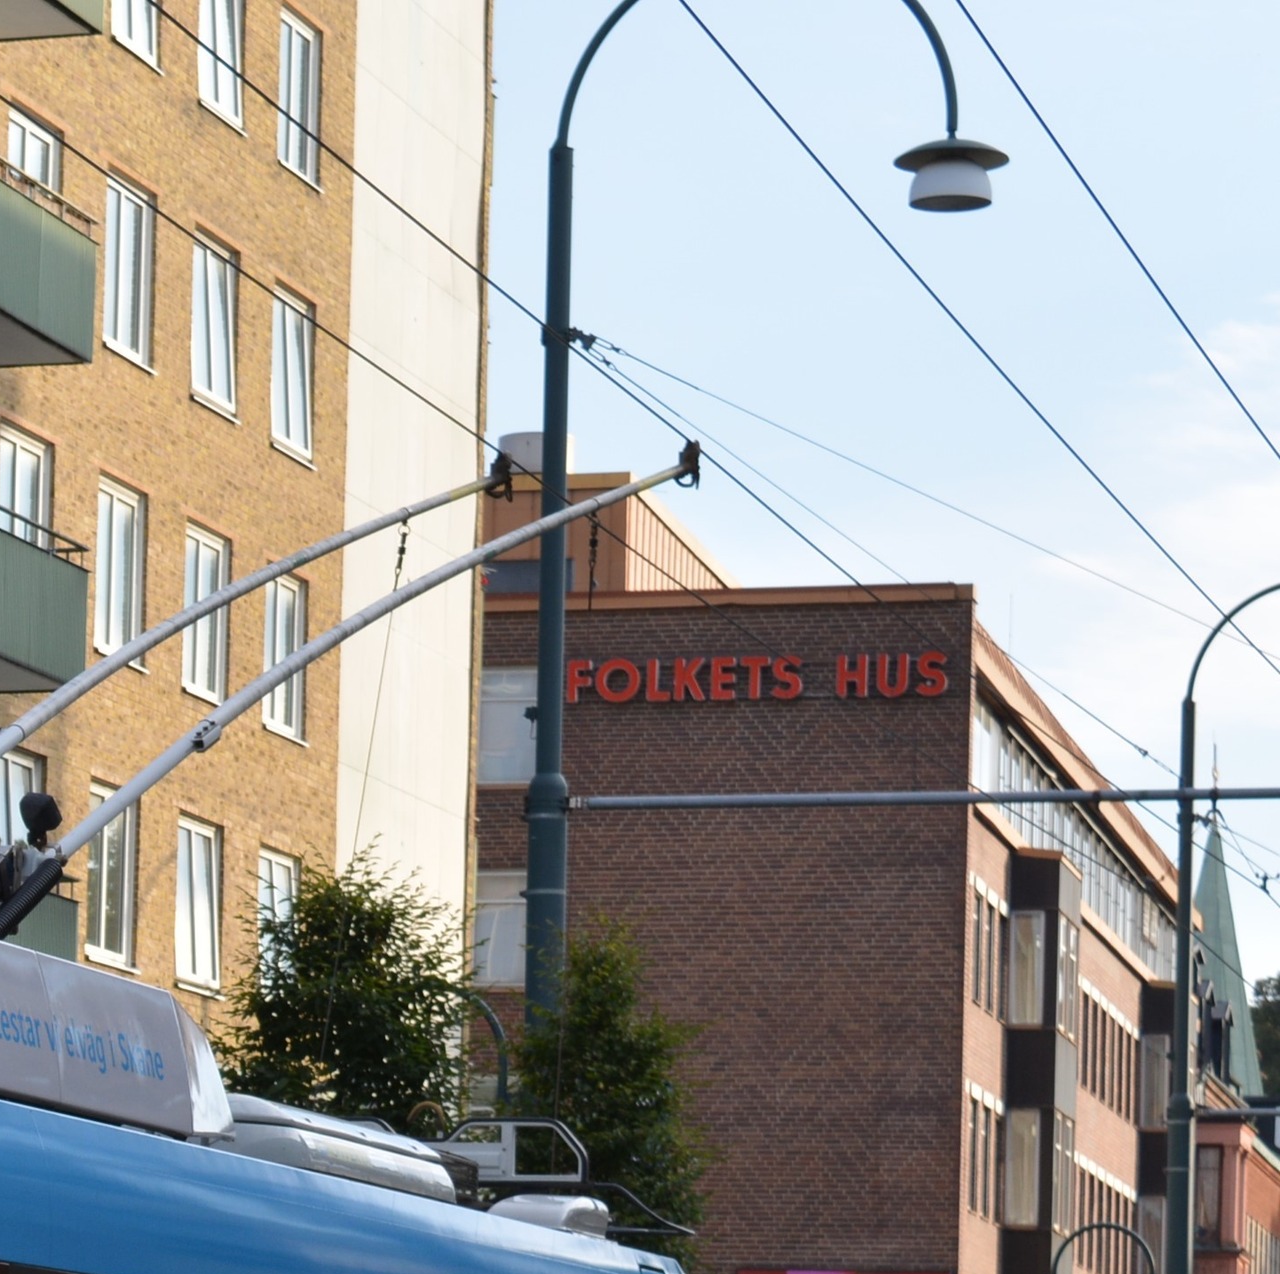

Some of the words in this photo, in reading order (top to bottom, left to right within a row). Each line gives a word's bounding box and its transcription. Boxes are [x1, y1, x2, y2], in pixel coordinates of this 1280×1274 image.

[566, 655, 803, 704] FOLKETS
[836, 651, 949, 698] HUS
[64, 1018, 107, 1074] elväg
[117, 1032, 165, 1081] Skåne
